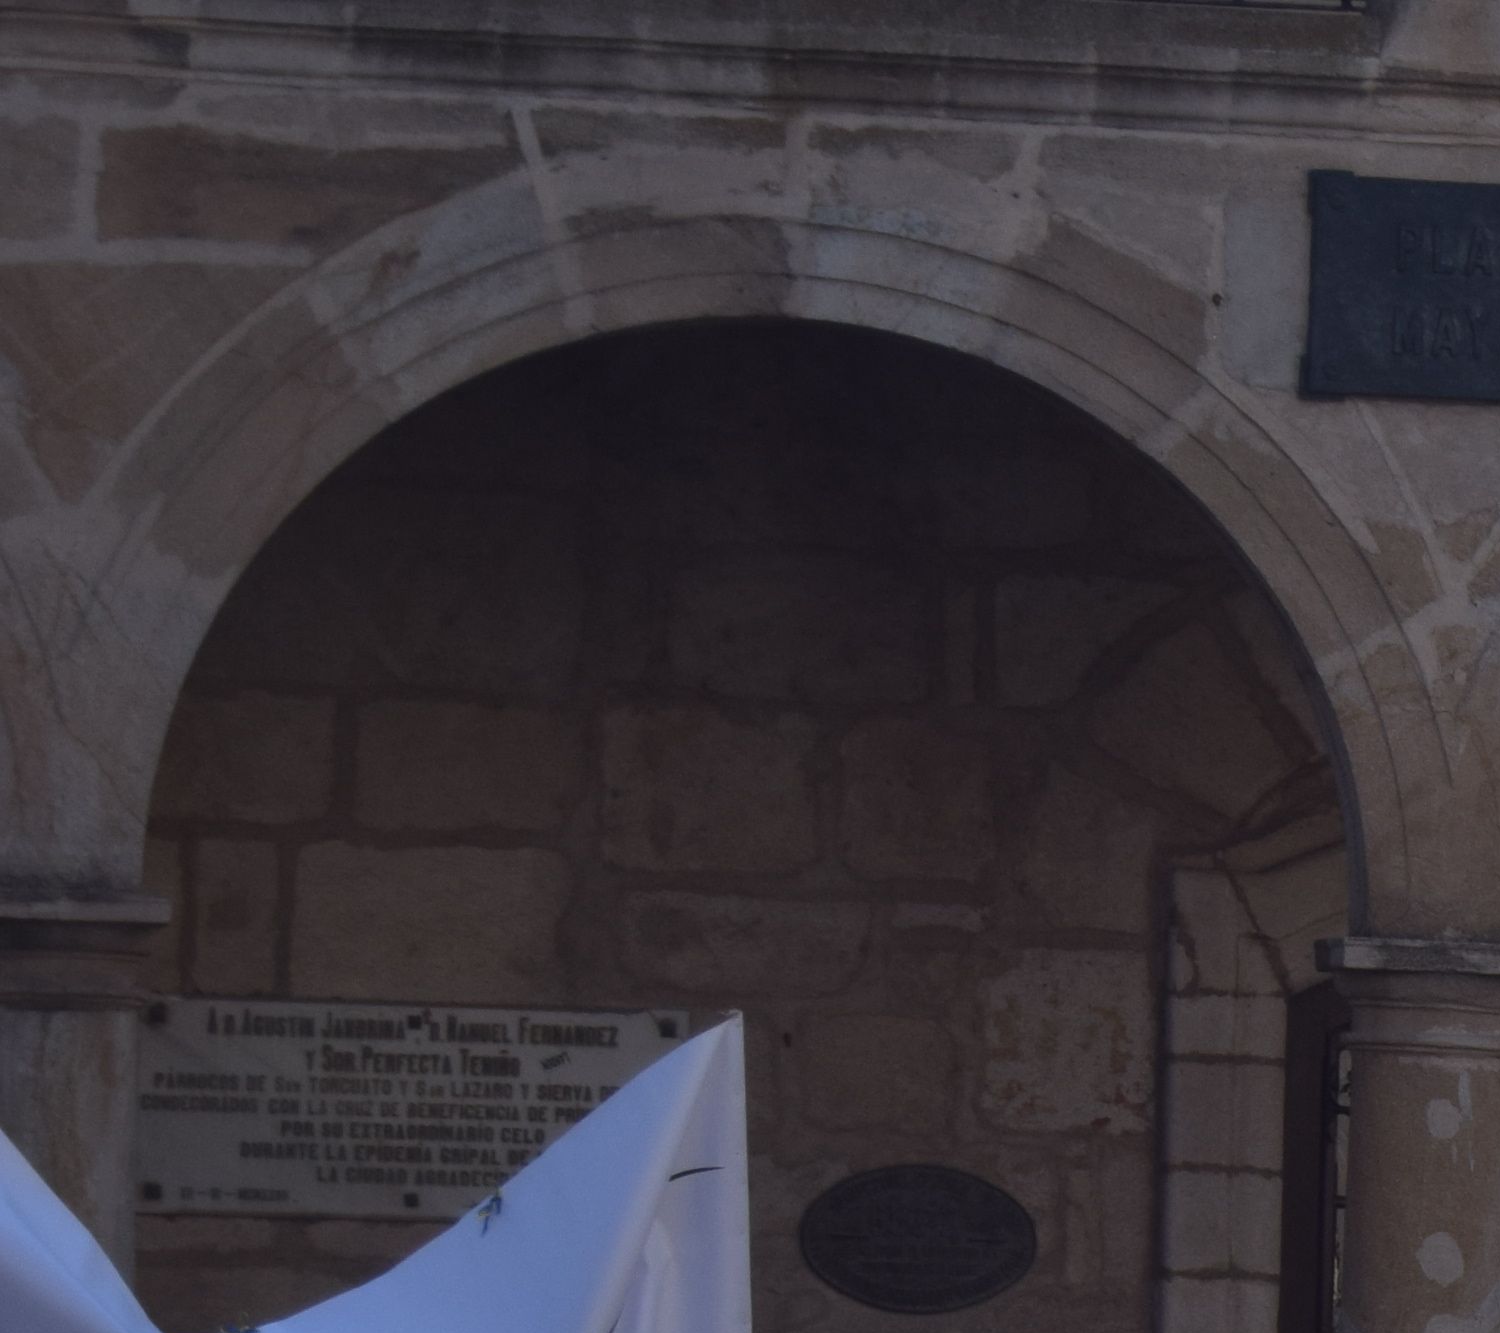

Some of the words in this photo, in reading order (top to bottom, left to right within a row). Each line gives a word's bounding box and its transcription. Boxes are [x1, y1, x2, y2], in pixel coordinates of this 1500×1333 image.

[359, 1046, 453, 1076] PERFECTA
[246, 1074, 267, 1092] DE
[308, 1077, 392, 1096] TORCUATO
[398, 1078, 409, 1096] Y
[520, 1083, 530, 1101] Y
[536, 1084, 593, 1102] SIERVA
[380, 1101, 401, 1118] DE
[407, 1102, 520, 1122] BENEFICENCIA
[527, 1105, 548, 1123] DE
[281, 1120, 314, 1138] POR
[321, 1122, 343, 1138] SU
[500, 1127, 545, 1145] CELO
[239, 1140, 319, 1160] DURANTE
[325, 1143, 346, 1161] LA
[316, 1167, 338, 1183] LA
